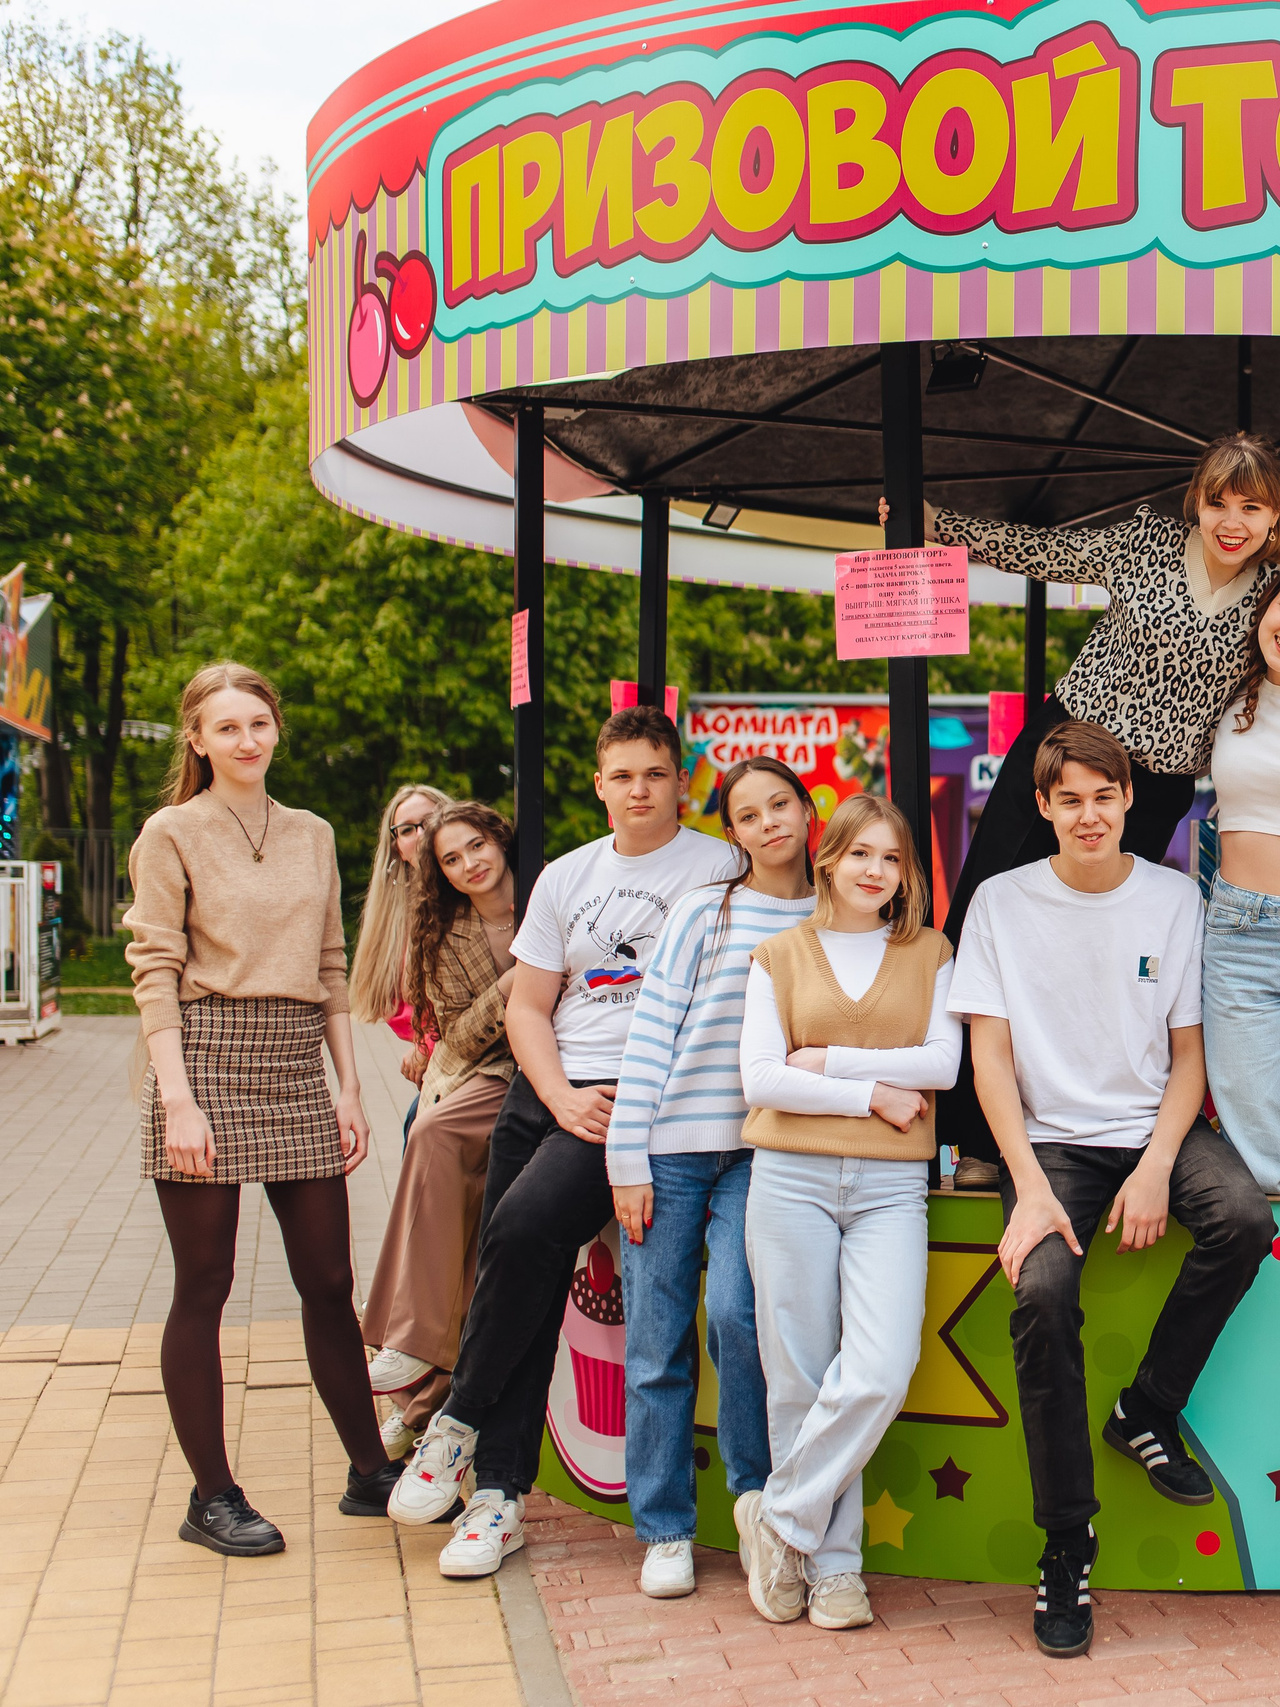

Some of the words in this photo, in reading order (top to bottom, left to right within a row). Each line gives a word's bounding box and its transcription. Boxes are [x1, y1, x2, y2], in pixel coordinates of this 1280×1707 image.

[450, 41, 1121, 291] ПРИЗОВОЙ
[854, 555, 870, 564] Игра
[872, 552, 919, 561] «ПРИЗОВОЙ
[921, 550, 948, 558] ТОРТ»
[845, 583, 850, 591] 5
[855, 582, 885, 590] попыток
[886, 580, 920, 588] накинуть
[898, 588, 921, 597] колбу.
[845, 600, 884, 610] ВЫИГРЫШ:
[885, 598, 919, 606] МЯГКАЯ
[919, 597, 961, 605] ИГРУШКА
[691, 711, 832, 735] КОМНАТА
